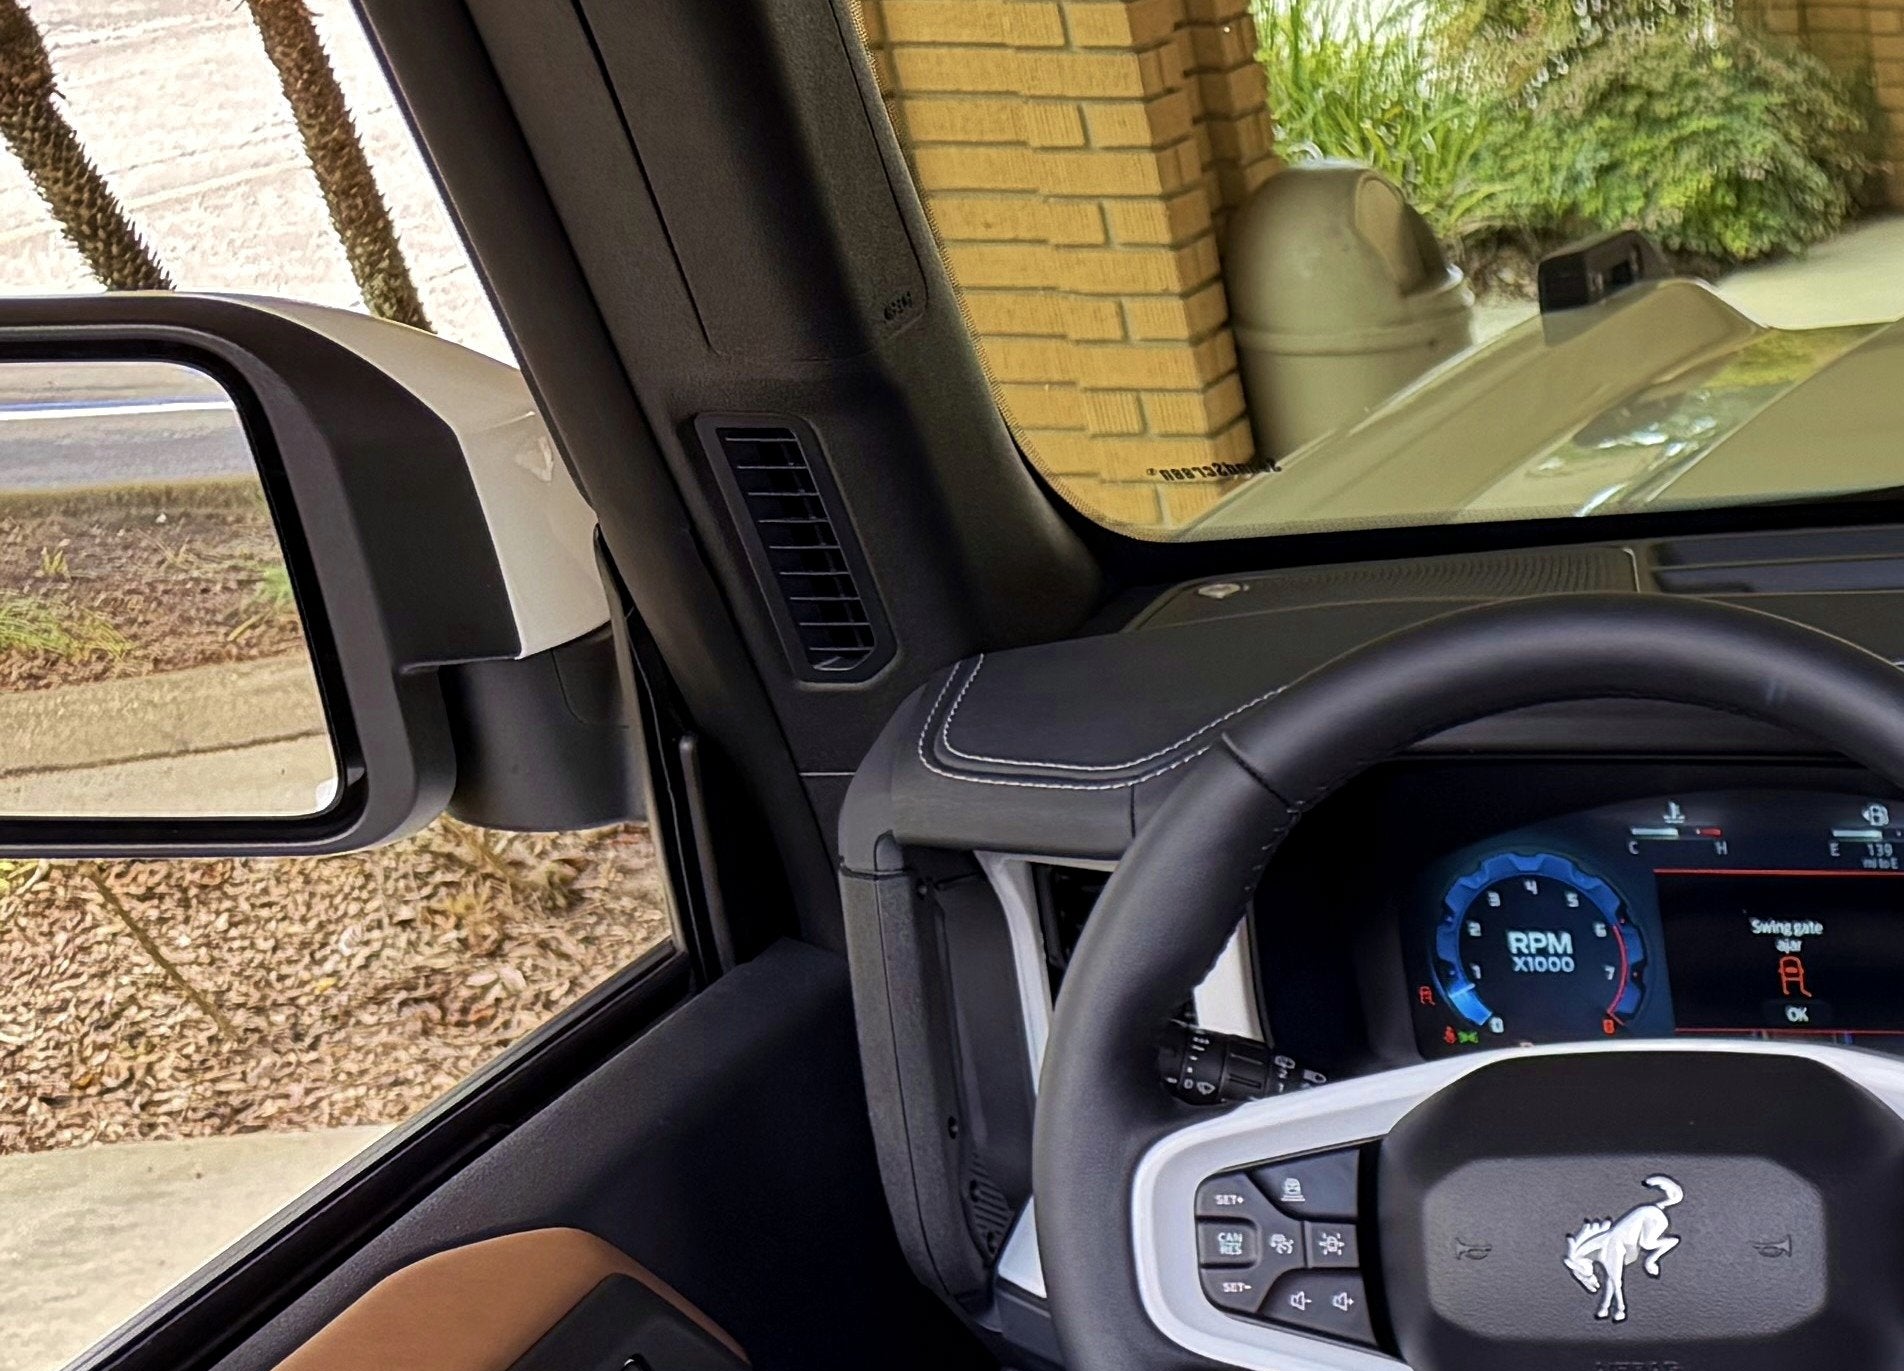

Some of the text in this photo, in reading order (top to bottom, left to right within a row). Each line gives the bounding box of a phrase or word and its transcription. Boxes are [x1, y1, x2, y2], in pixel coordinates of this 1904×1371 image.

[1628, 841, 1639, 855] C
[1716, 841, 1728, 855] H
[1829, 842, 1840, 857] E
[1525, 880, 1538, 895] 4
[1488, 891, 1501, 907] 3
[1565, 891, 1579, 908] 5
[1468, 921, 1482, 937] 2
[1593, 922, 1607, 937] 6
[1751, 920, 1824, 937] Swing gate
[1507, 931, 1574, 955] RPM
[1776, 939, 1802, 954] ajar
[1472, 964, 1482, 979] 1
[1513, 957, 1575, 972] X1000
[1604, 965, 1615, 980] 7
[1786, 1007, 1809, 1023] OK
[1489, 1017, 1504, 1033] 0
[1215, 1194, 1244, 1206] SET+
[1218, 1232, 1243, 1242] CAN
